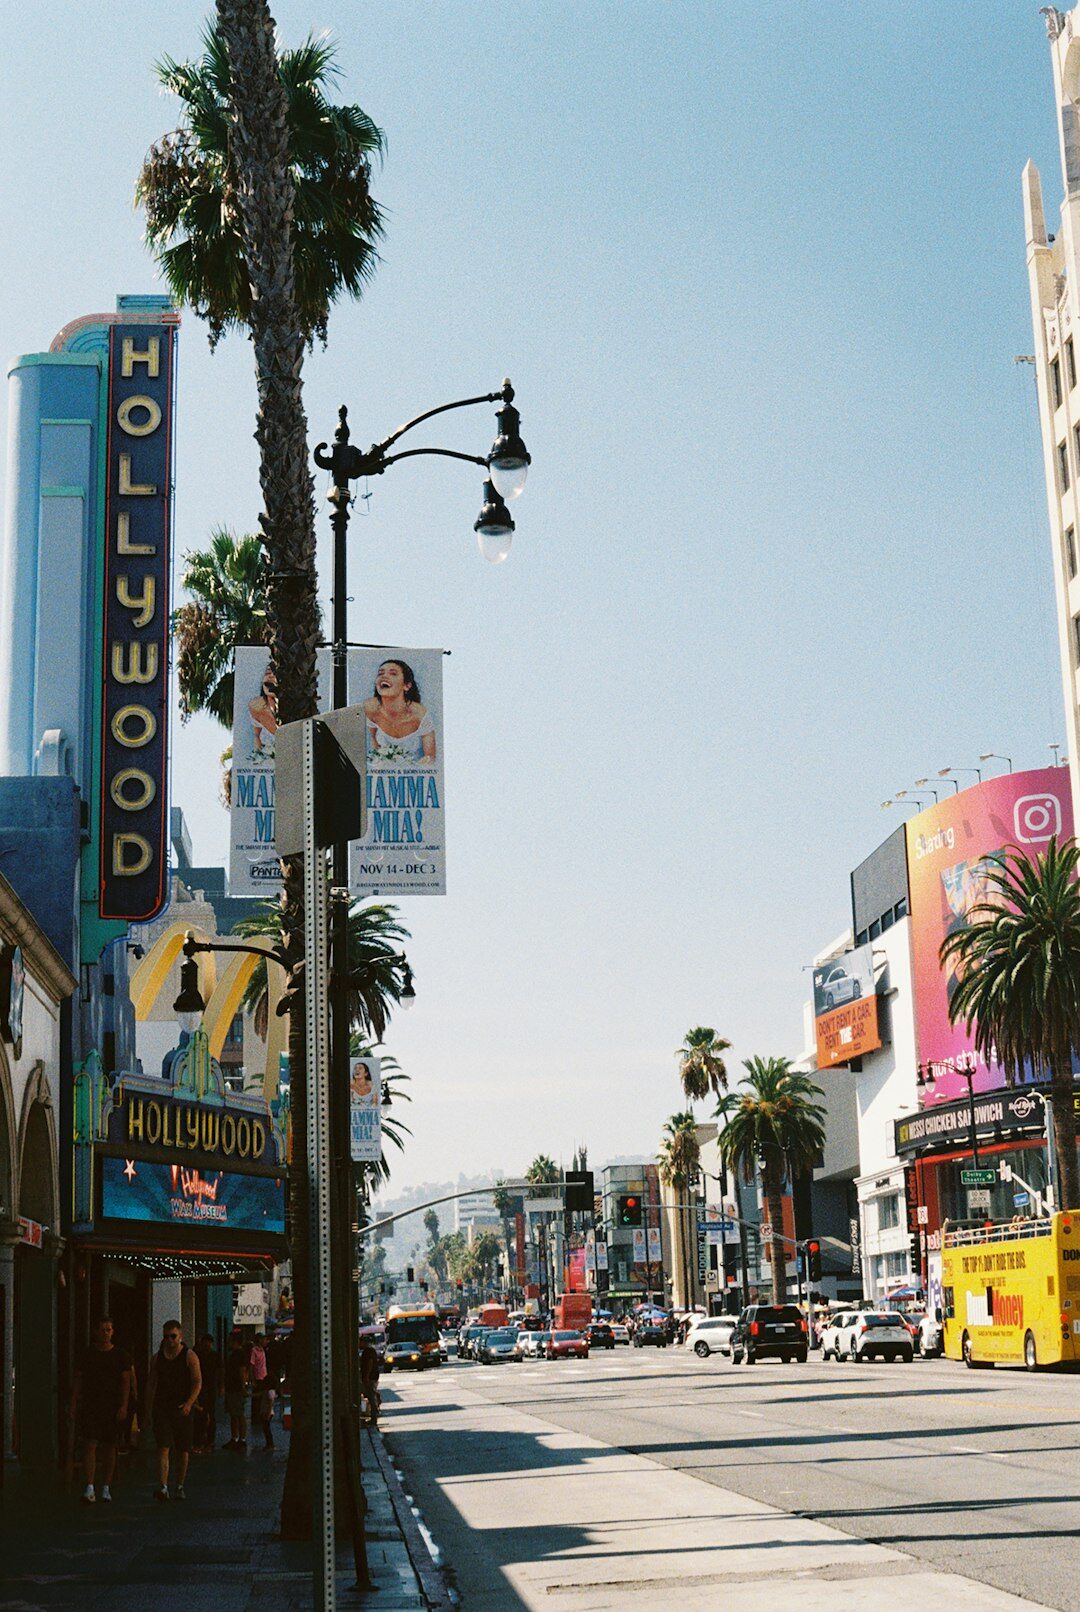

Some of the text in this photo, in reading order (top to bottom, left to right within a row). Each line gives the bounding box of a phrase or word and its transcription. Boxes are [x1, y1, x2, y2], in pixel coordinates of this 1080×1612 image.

[110, 336, 162, 876] HOLLYWOOD
[373, 809, 423, 843] MIA!
[360, 864, 383, 874] NOV
[387, 864, 397, 874] 14
[406, 864, 427, 874] DEC
[430, 864, 436, 874] 3
[836, 1009, 852, 1031] RENT
[128, 1099, 266, 1159] HOLLYWOOD
[925, 1111, 957, 1135] CHICKEN
[992, 1289, 1024, 1331] Money
